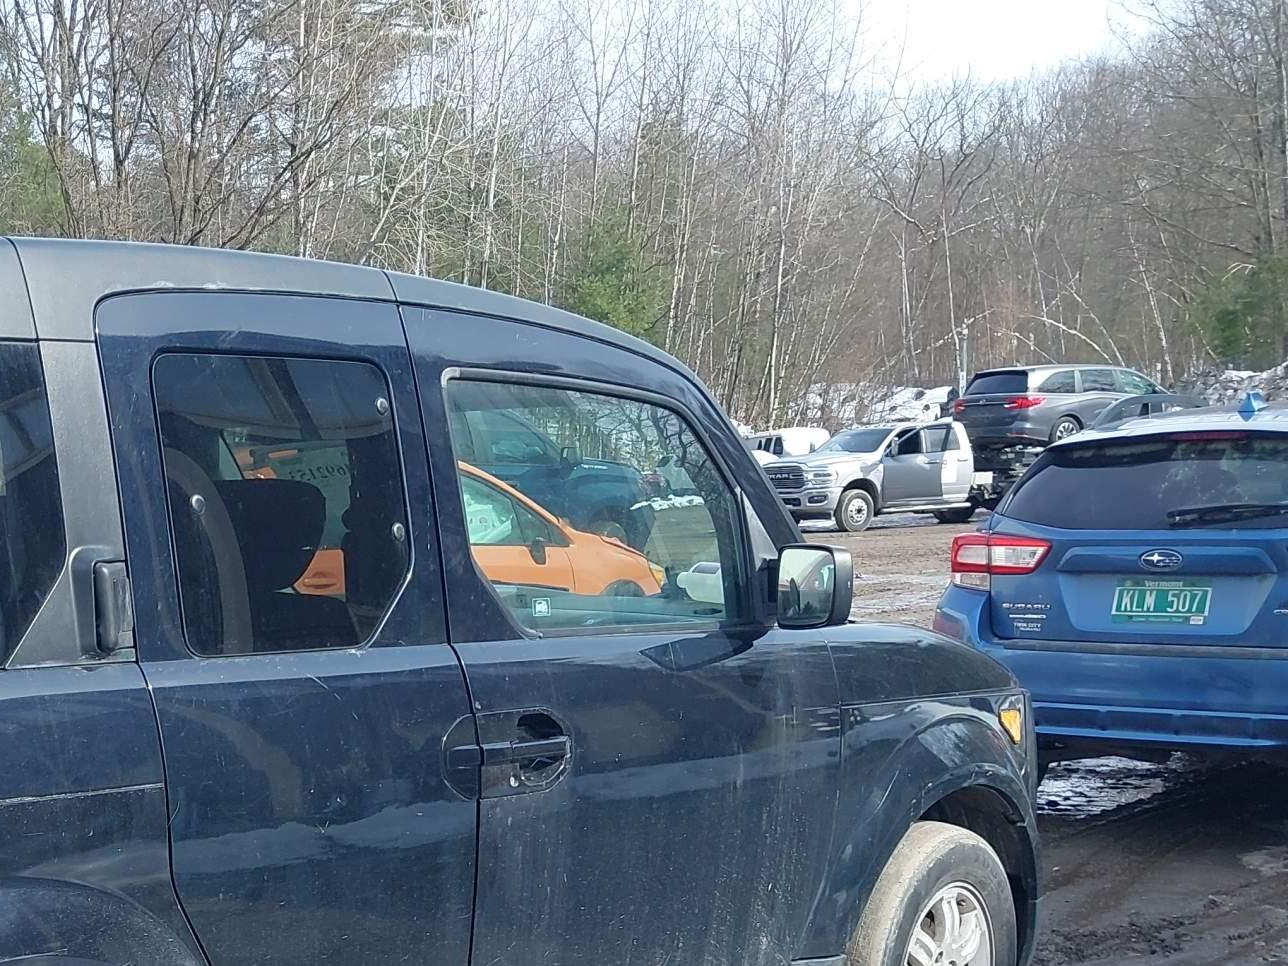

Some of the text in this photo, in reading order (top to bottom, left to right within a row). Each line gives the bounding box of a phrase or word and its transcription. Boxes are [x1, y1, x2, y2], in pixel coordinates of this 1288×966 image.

[1144, 580, 1184, 588] Vermont
[1121, 590, 1203, 612] KLM 507
